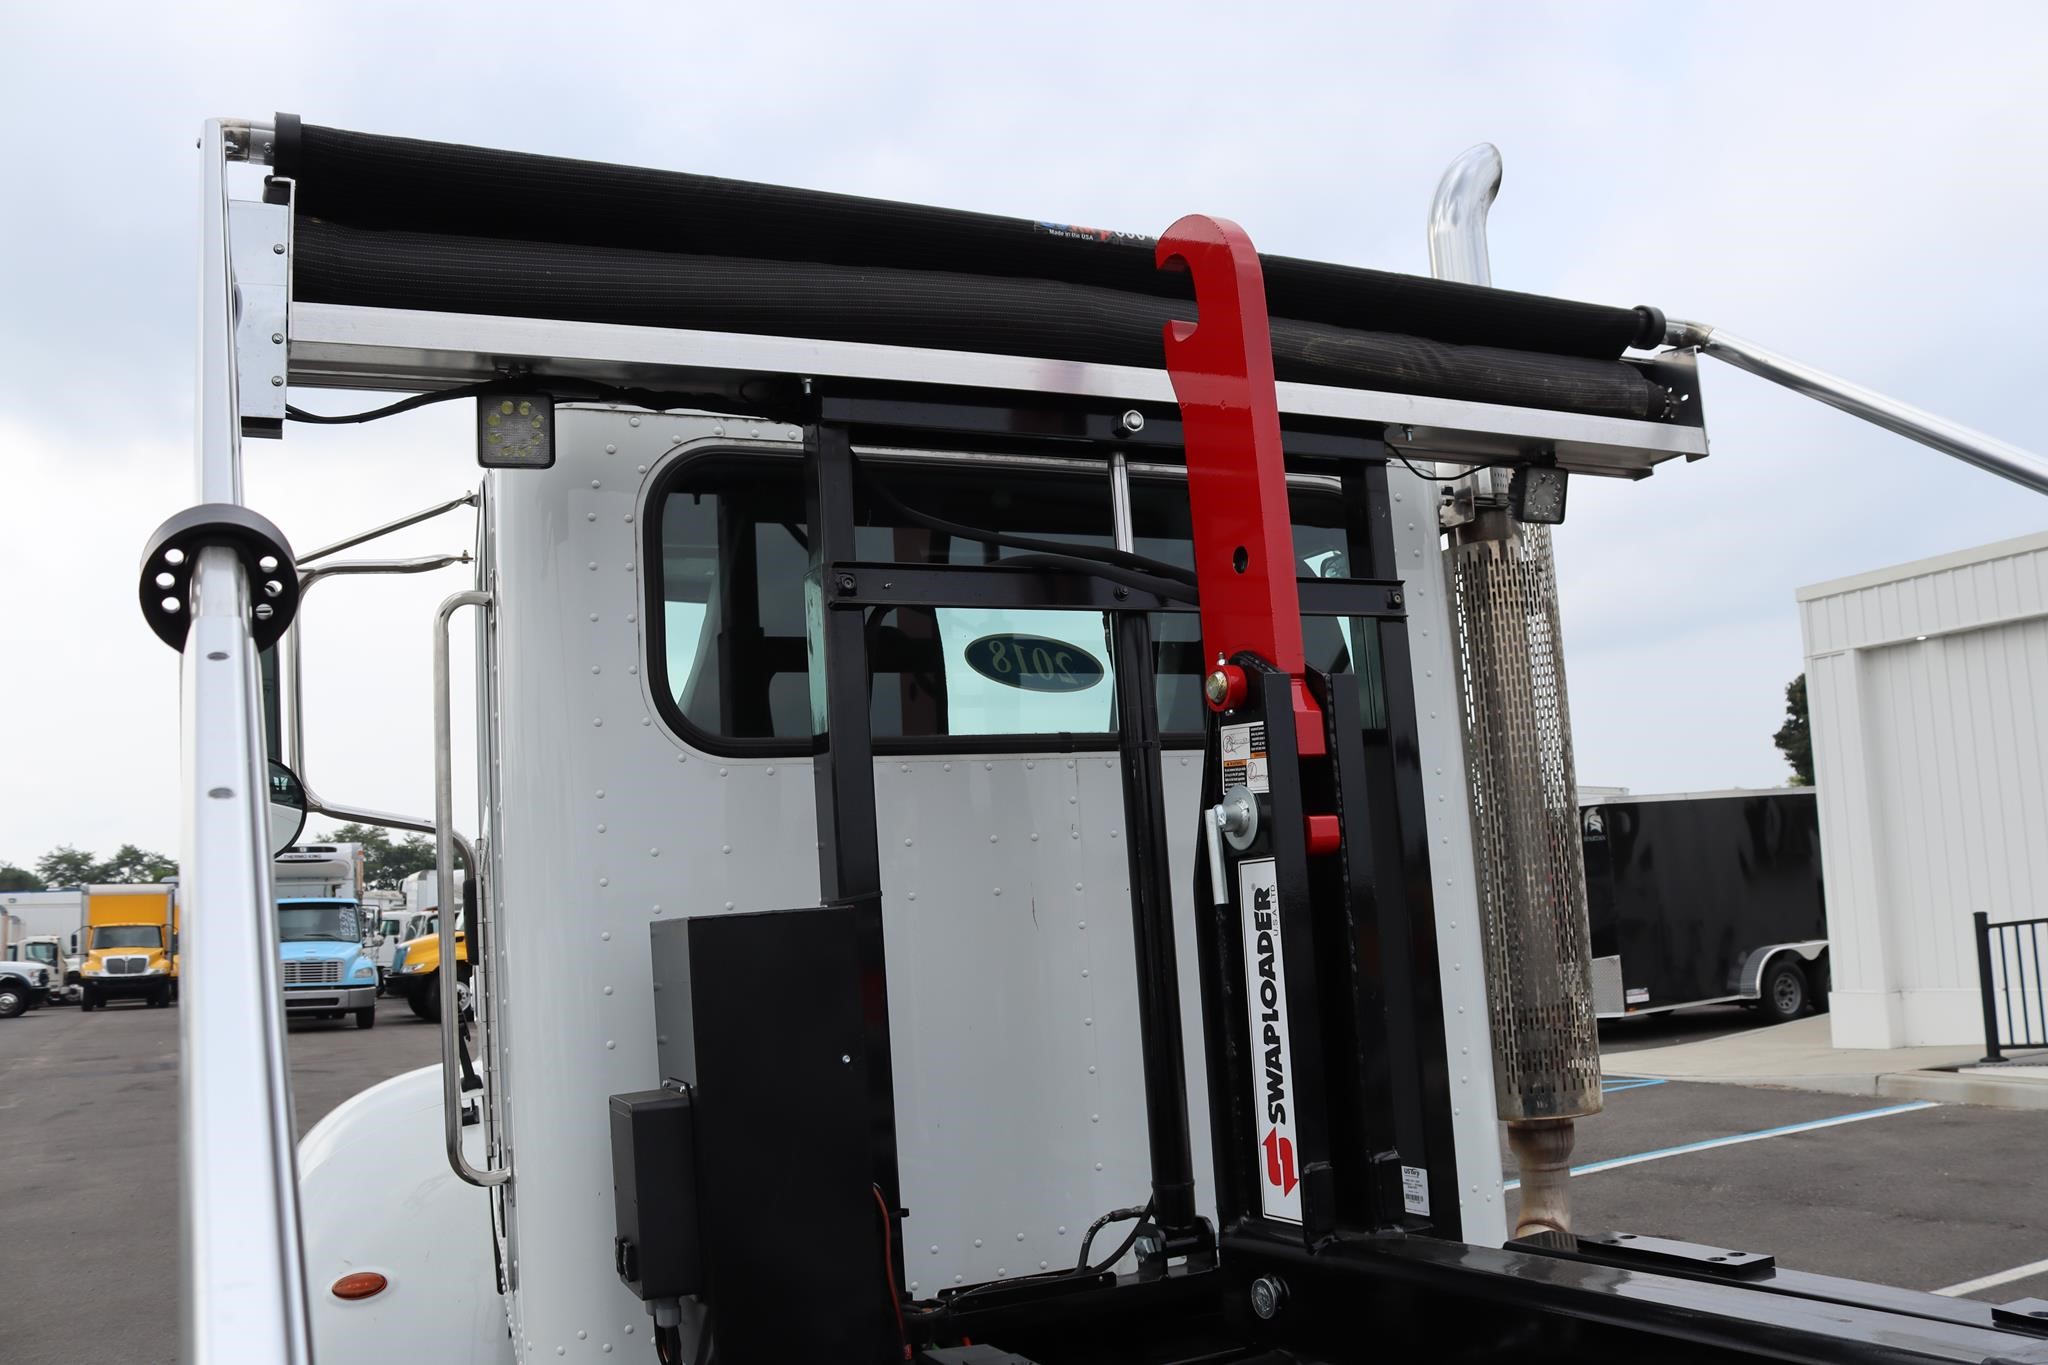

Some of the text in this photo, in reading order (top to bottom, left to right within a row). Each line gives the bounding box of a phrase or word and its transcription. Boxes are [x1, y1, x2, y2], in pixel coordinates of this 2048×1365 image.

[1049, 229, 1064, 237] Made
[1081, 233, 1094, 241] USA
[1271, 906, 1279, 937] U.S.A.
[1254, 887, 1285, 1124] SWAPLOADER
